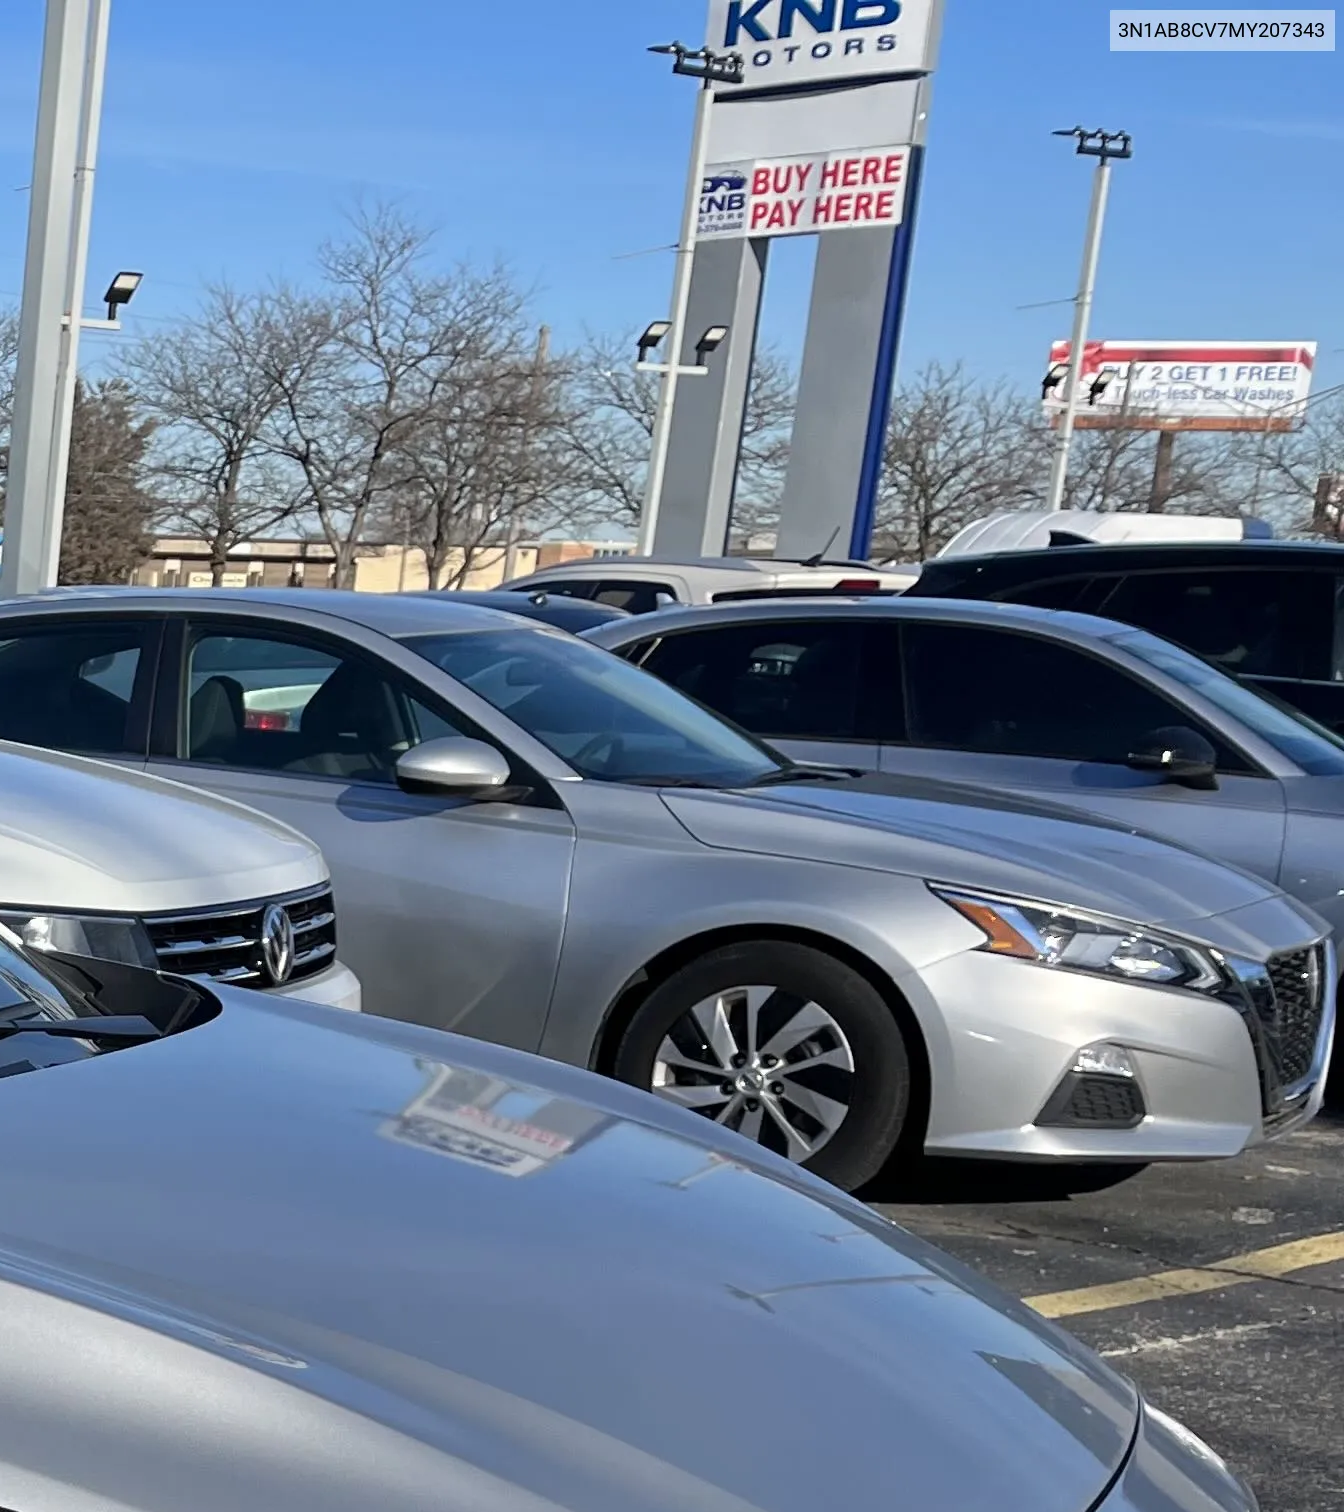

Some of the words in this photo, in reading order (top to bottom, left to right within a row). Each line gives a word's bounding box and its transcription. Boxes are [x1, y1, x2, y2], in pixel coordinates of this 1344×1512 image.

[753, 34, 896, 66] OTORS
[751, 163, 813, 195] BUY
[819, 154, 904, 189] HERE
[750, 198, 806, 229] PAY
[813, 190, 896, 225] HERE
[1151, 367, 1162, 381] 2
[1168, 366, 1210, 381] GET
[1219, 367, 1226, 381] 1
[1235, 366, 1297, 381] FREE!
[1234, 386, 1293, 401] Washes
